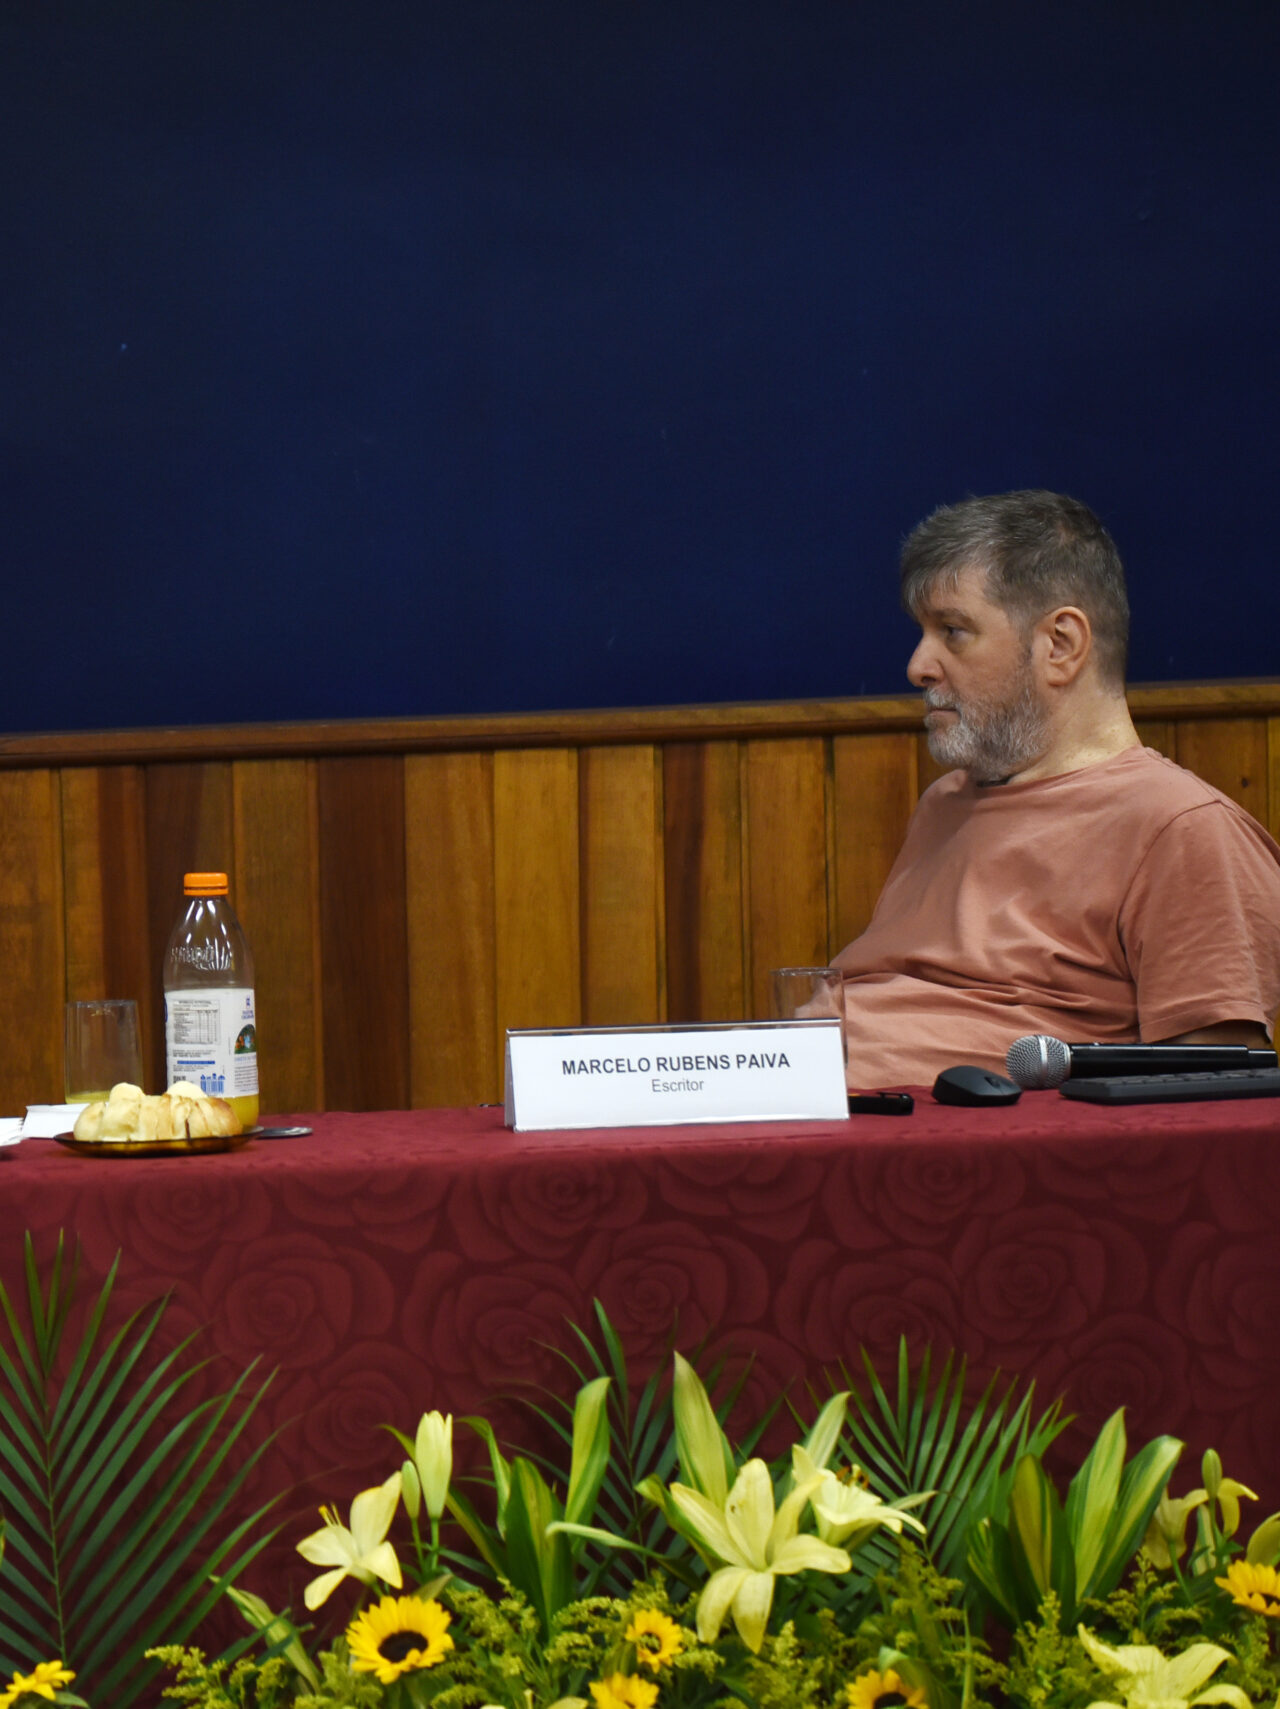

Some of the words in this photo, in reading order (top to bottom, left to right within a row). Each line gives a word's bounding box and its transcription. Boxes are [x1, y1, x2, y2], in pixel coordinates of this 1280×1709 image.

[562, 1057, 651, 1075] MARCELO
[656, 1054, 731, 1072] RUBENS
[736, 1052, 791, 1069] PAIVA
[651, 1077, 705, 1093] Escritor
